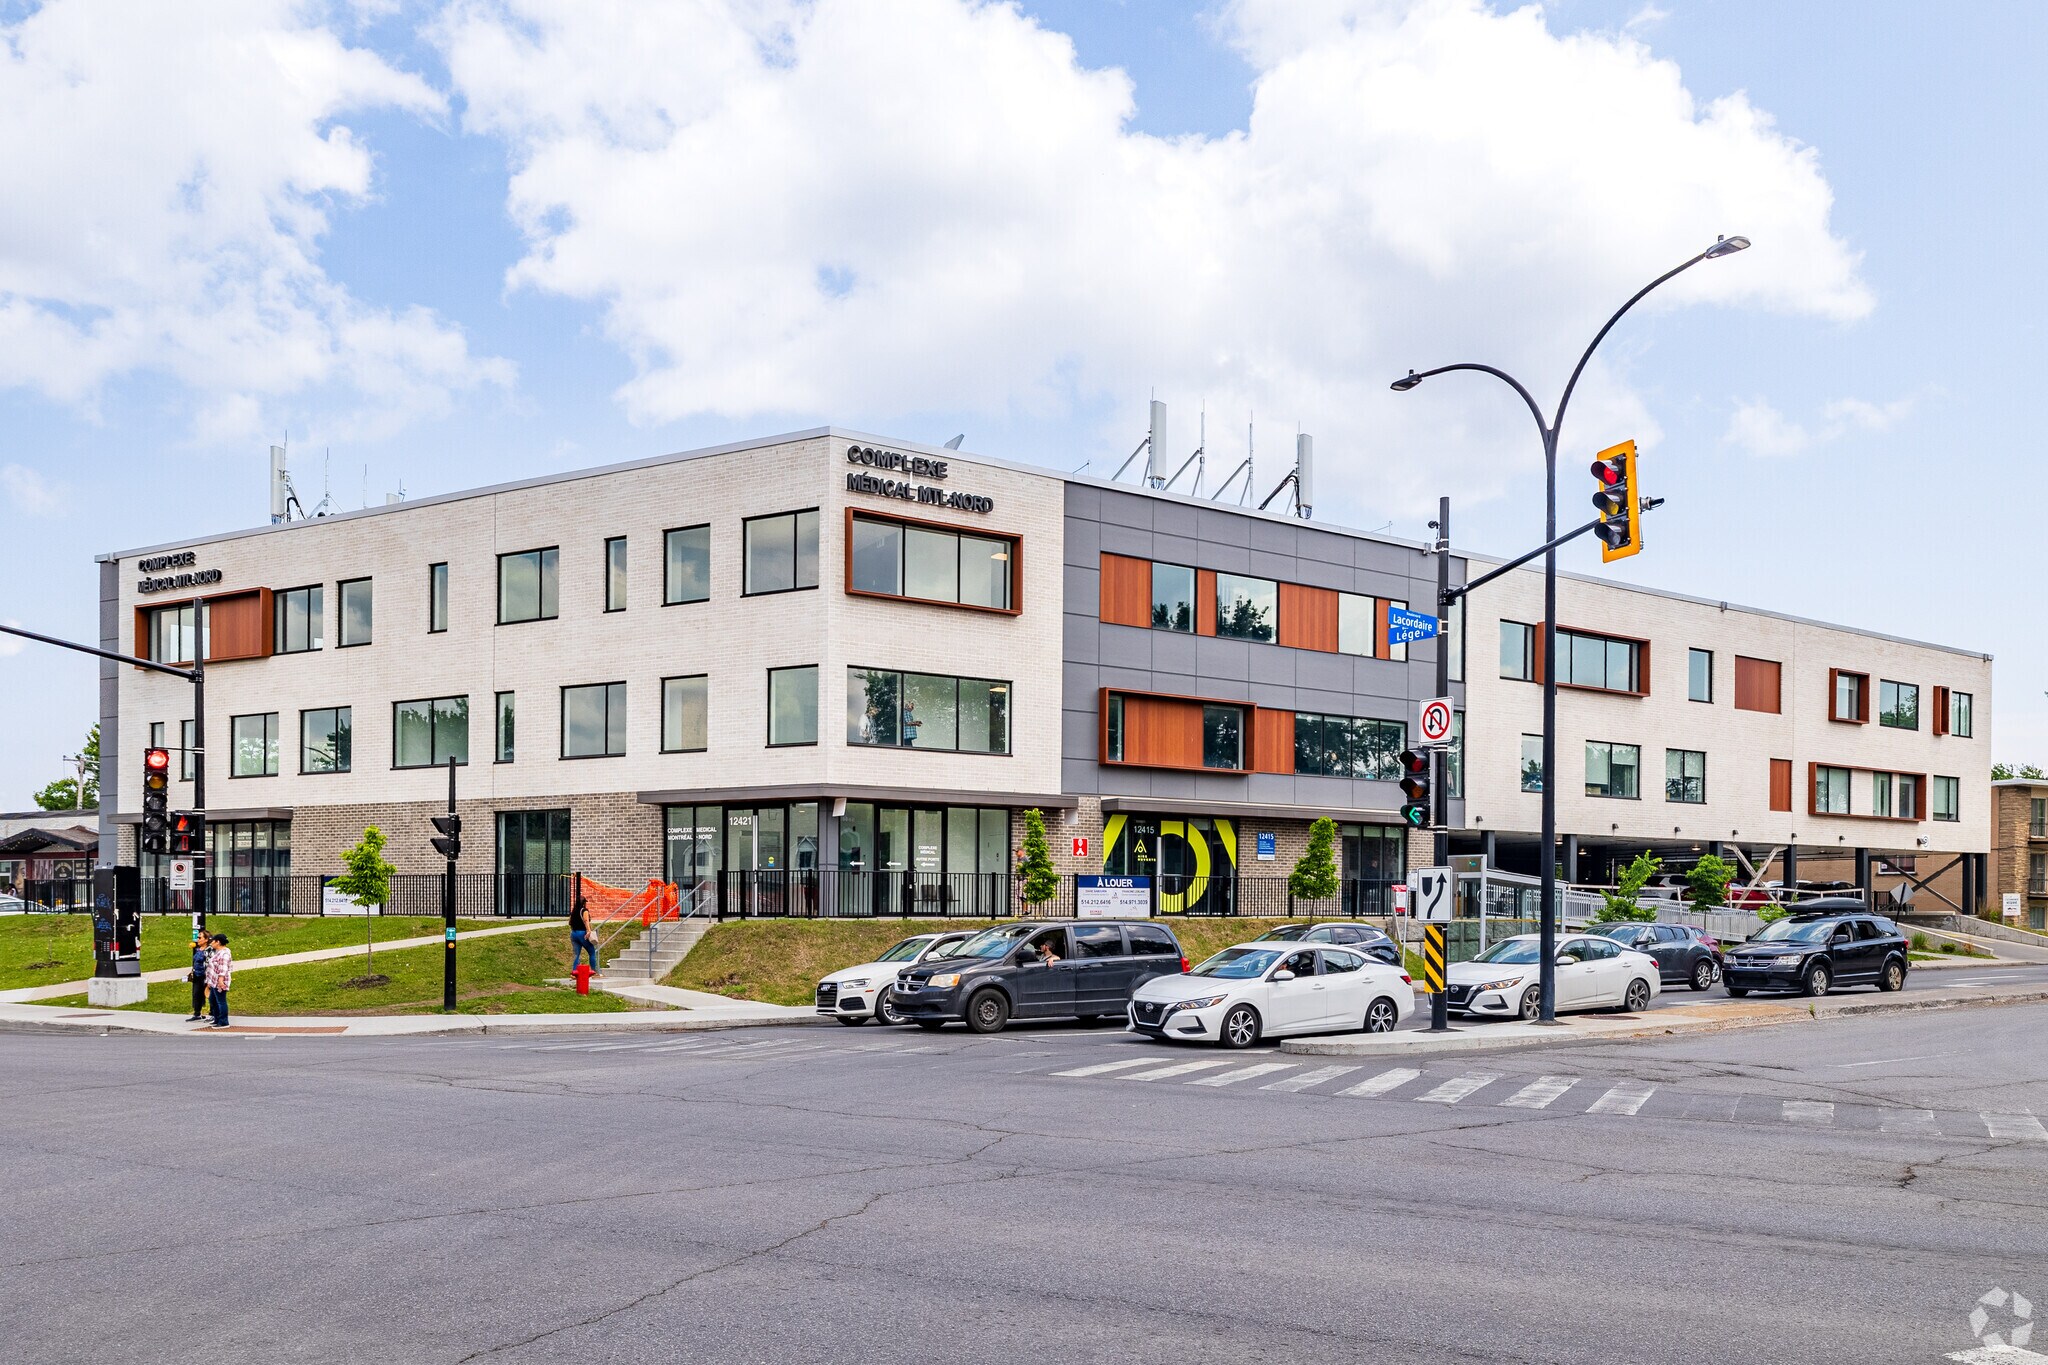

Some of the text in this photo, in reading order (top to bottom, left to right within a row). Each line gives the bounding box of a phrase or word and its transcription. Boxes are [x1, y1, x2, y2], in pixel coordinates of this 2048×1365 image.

[847, 445, 948, 479] COMPLEXE
[846, 471, 994, 513] MÉDICAL MTL-NORD
[138, 551, 197, 572] COMPLEXE
[1393, 613, 1433, 632] Lacordaire
[729, 816, 752, 826] 12421
[667, 833, 694, 841] MONTRÉAL
[1133, 825, 1155, 834] 12415
[1097, 876, 1133, 888] À LOUER
